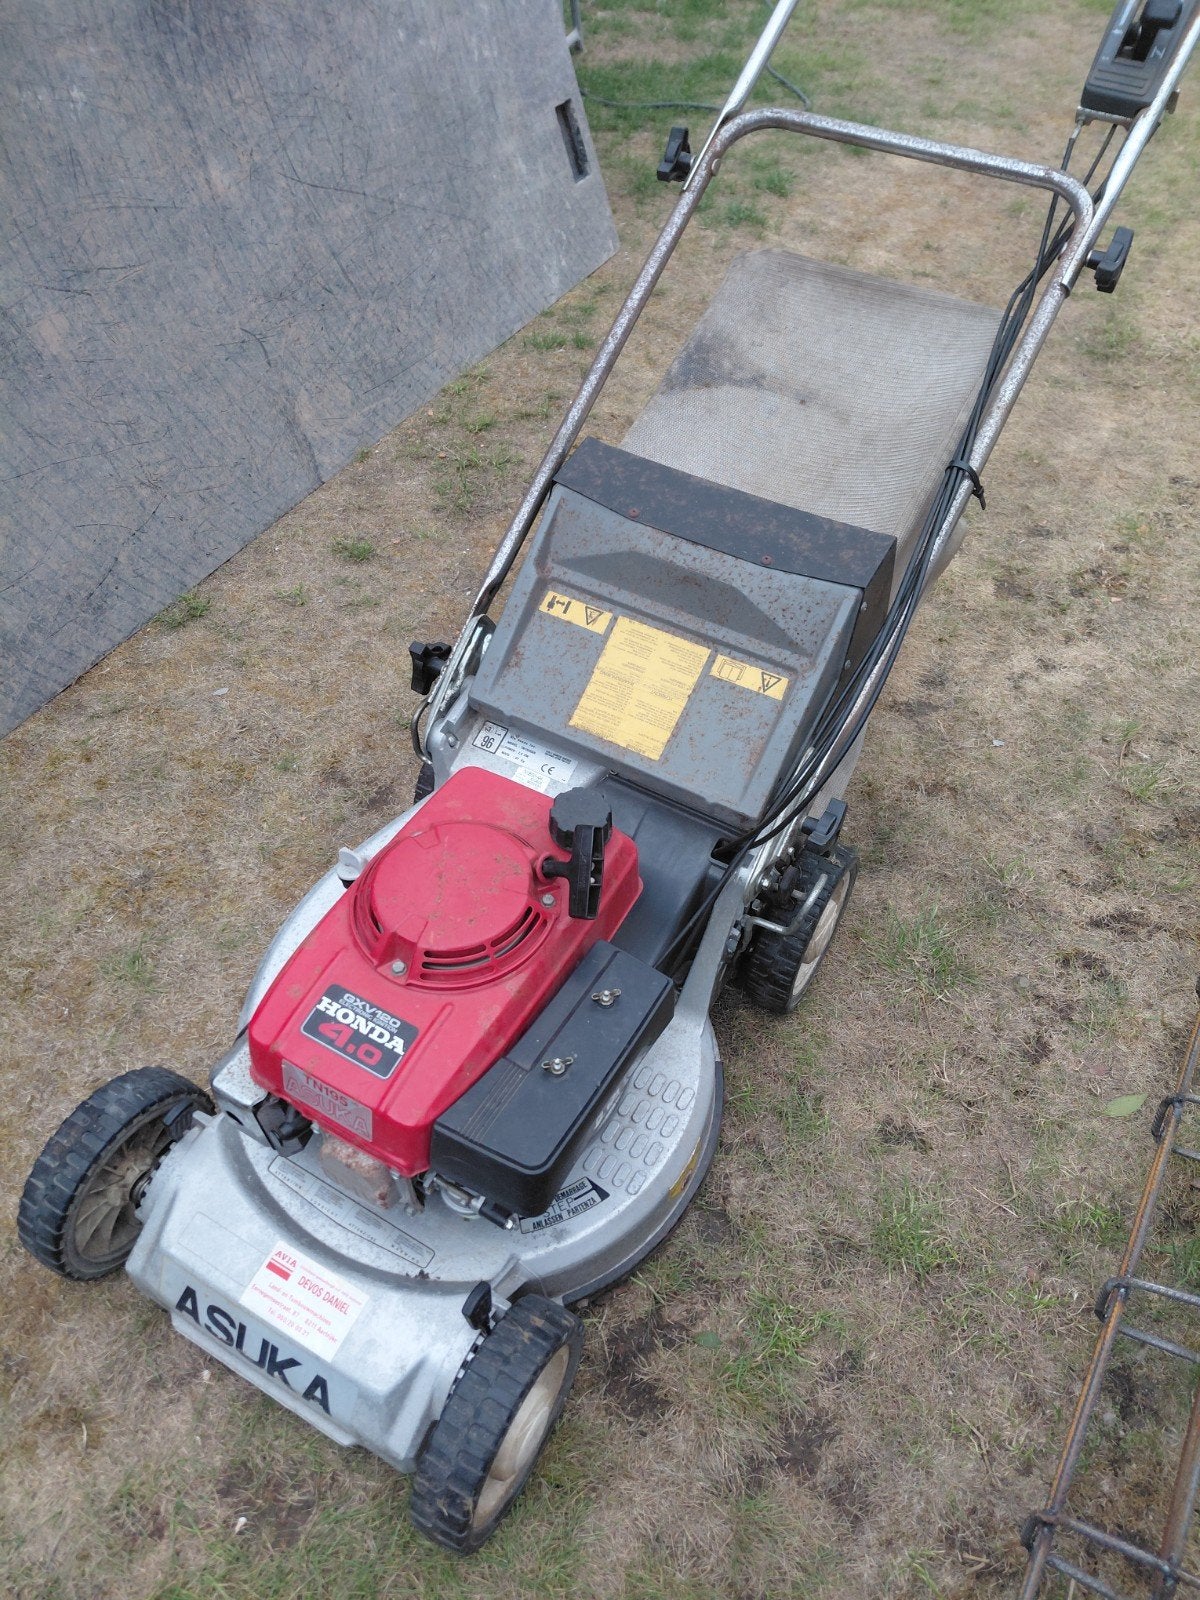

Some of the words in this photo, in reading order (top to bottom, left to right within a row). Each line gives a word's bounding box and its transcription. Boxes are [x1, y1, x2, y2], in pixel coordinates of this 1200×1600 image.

[480, 735, 495, 749] 96
[315, 995, 404, 1055] HONDA
[338, 998, 373, 1020] ELECTRONIC
[372, 1017, 398, 1034] IGNITION
[342, 992, 401, 1028] GXV120
[318, 1020, 383, 1067] 4.0
[285, 1077, 369, 1138] ASUKA
[532, 1212, 563, 1230] ANLASSEN
[566, 1196, 597, 1216] PARTENZA
[274, 1249, 297, 1268] AVIA
[297, 1275, 324, 1297] DEVOS
[322, 1291, 350, 1315] DANIEL
[175, 1285, 332, 1416] ASUKA
